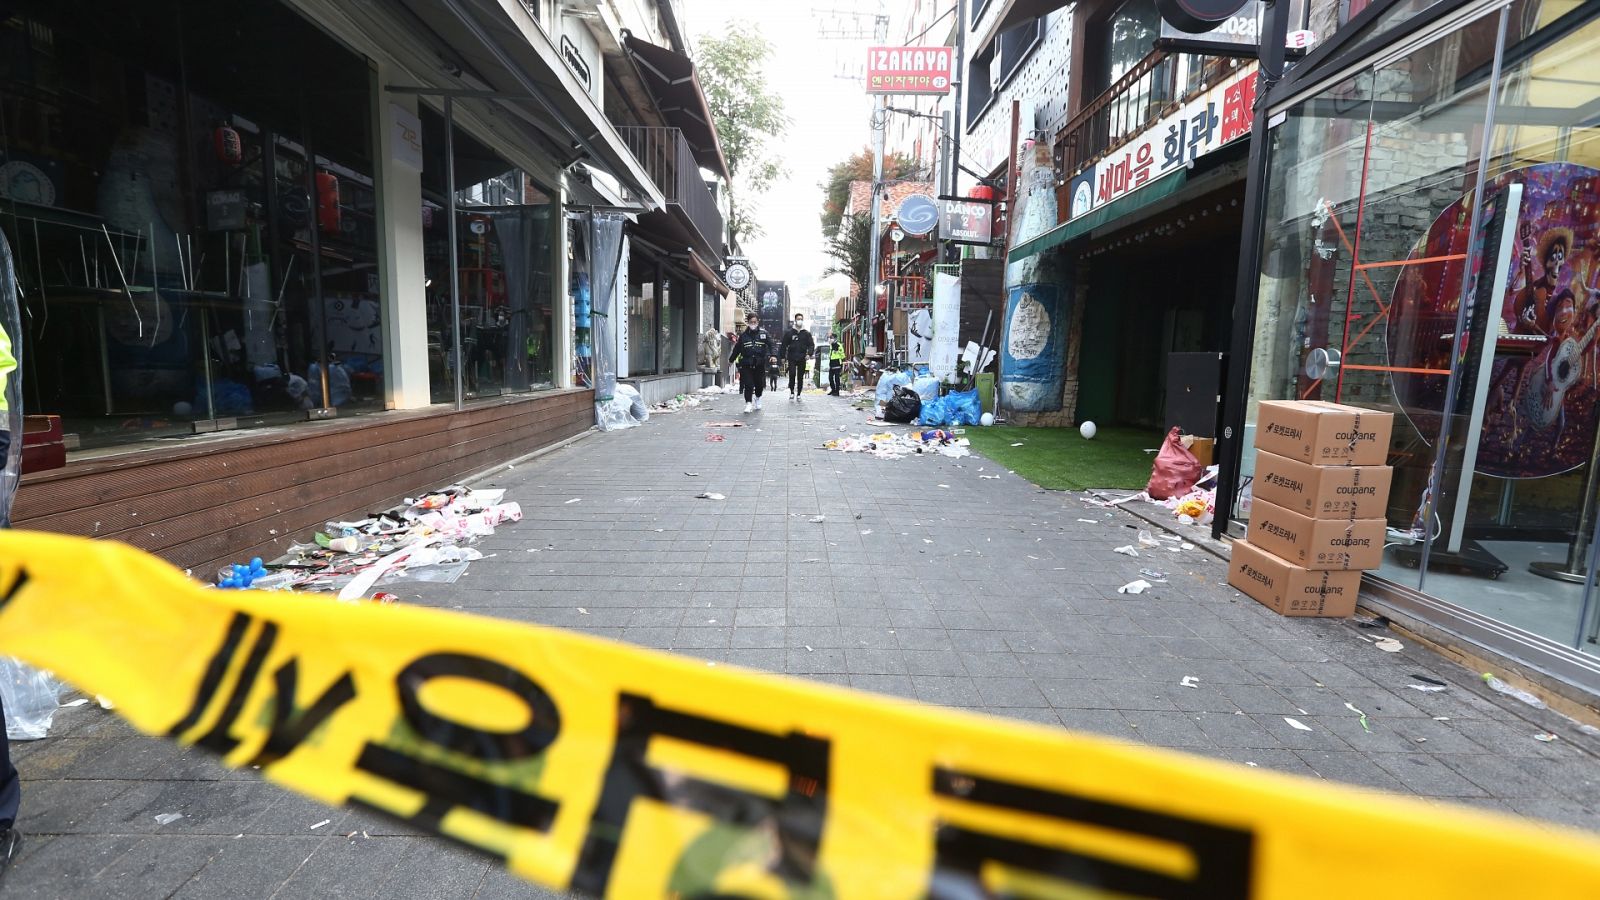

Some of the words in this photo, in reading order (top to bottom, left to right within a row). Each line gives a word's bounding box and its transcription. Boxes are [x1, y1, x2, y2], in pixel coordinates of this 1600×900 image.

[870, 50, 948, 71] IZAKAYA
[935, 78, 945, 88] 2F
[1096, 142, 1154, 202] 새마을
[1161, 102, 1219, 171] 회관
[945, 202, 986, 217] DANCO
[961, 215, 969, 228] 2
[1273, 424, 1303, 441] 로켓프레시
[1335, 431, 1376, 443] coupang
[1272, 474, 1303, 494] 로켓프레시
[1336, 485, 1376, 497] coupang
[1267, 523, 1297, 543] 로켓프레시
[1330, 536, 1370, 548] coupang
[1246, 567, 1274, 590] 로켓프레시
